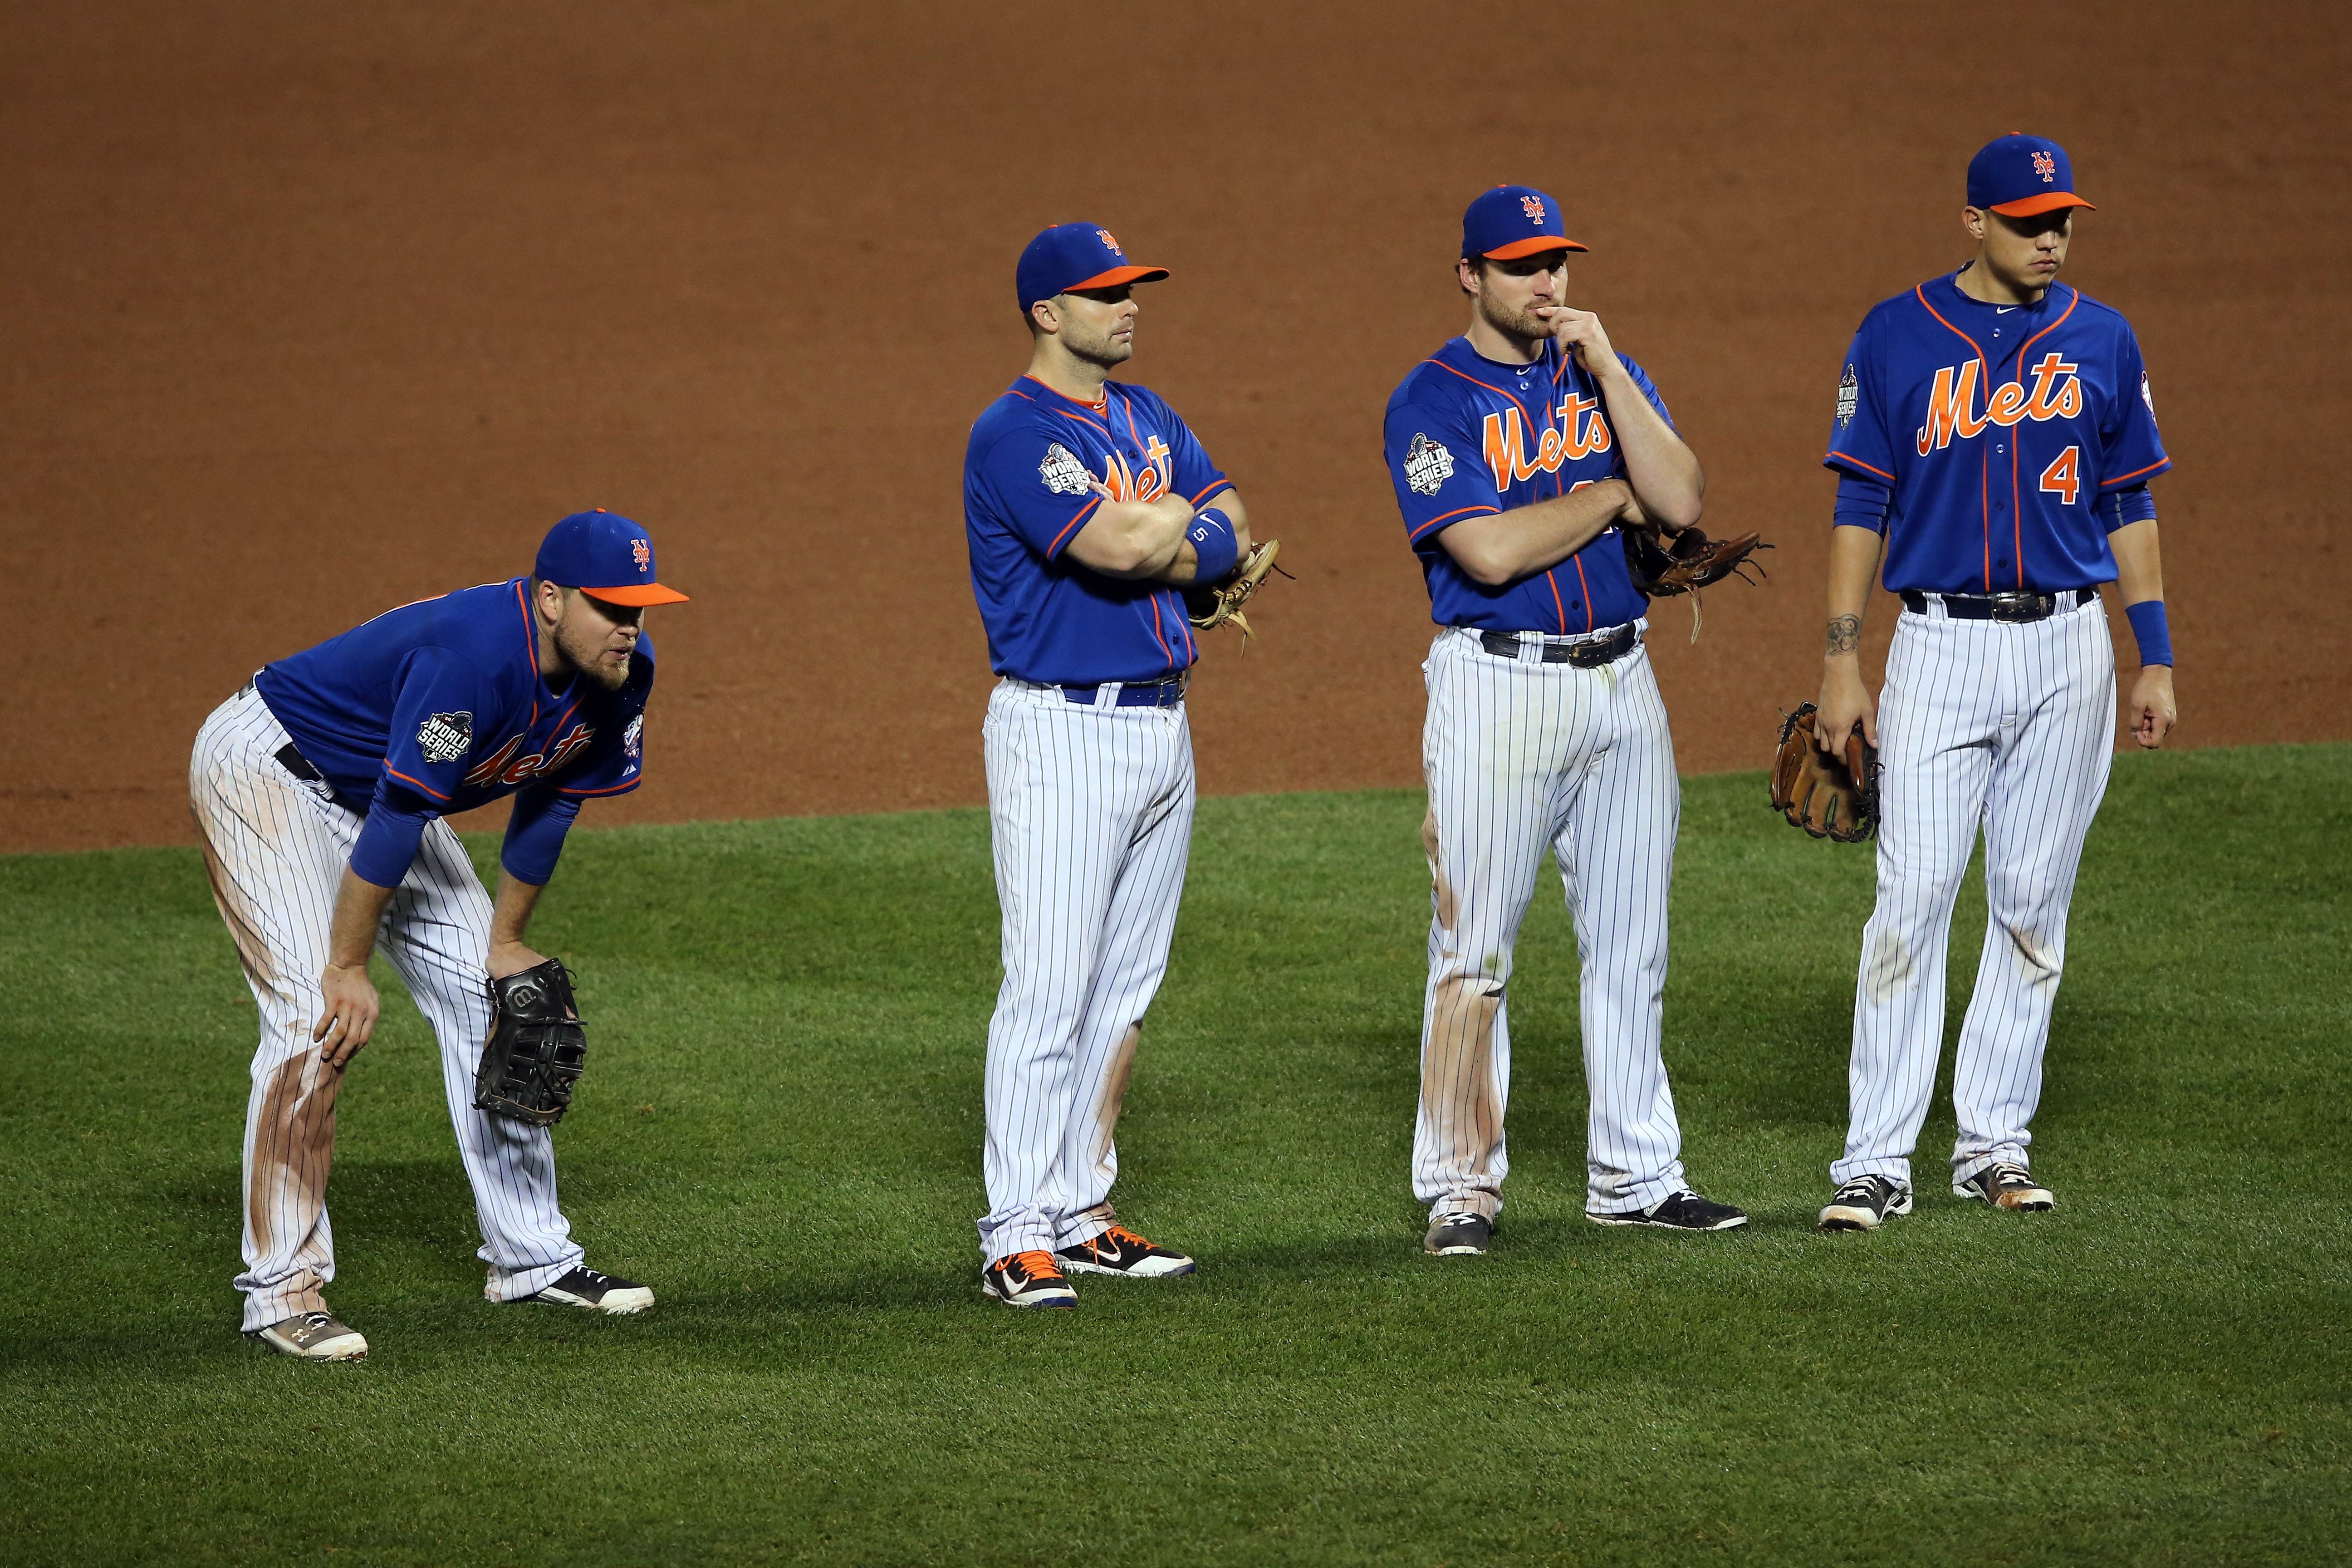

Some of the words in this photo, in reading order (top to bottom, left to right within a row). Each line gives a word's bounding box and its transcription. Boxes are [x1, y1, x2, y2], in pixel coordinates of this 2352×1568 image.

[1839, 386, 1856, 402] WORLD
[1917, 353, 2083, 457] Mets
[1483, 392, 1612, 493] Mets
[1103, 434, 1173, 503] Met
[1406, 447, 1446, 477] WORLD
[1410, 461, 1451, 490] SERIES
[2039, 446, 2080, 505] 4
[1193, 527, 1209, 542] 5
[418, 728, 461, 760] SERIES
[428, 716, 470, 749] WORLD
